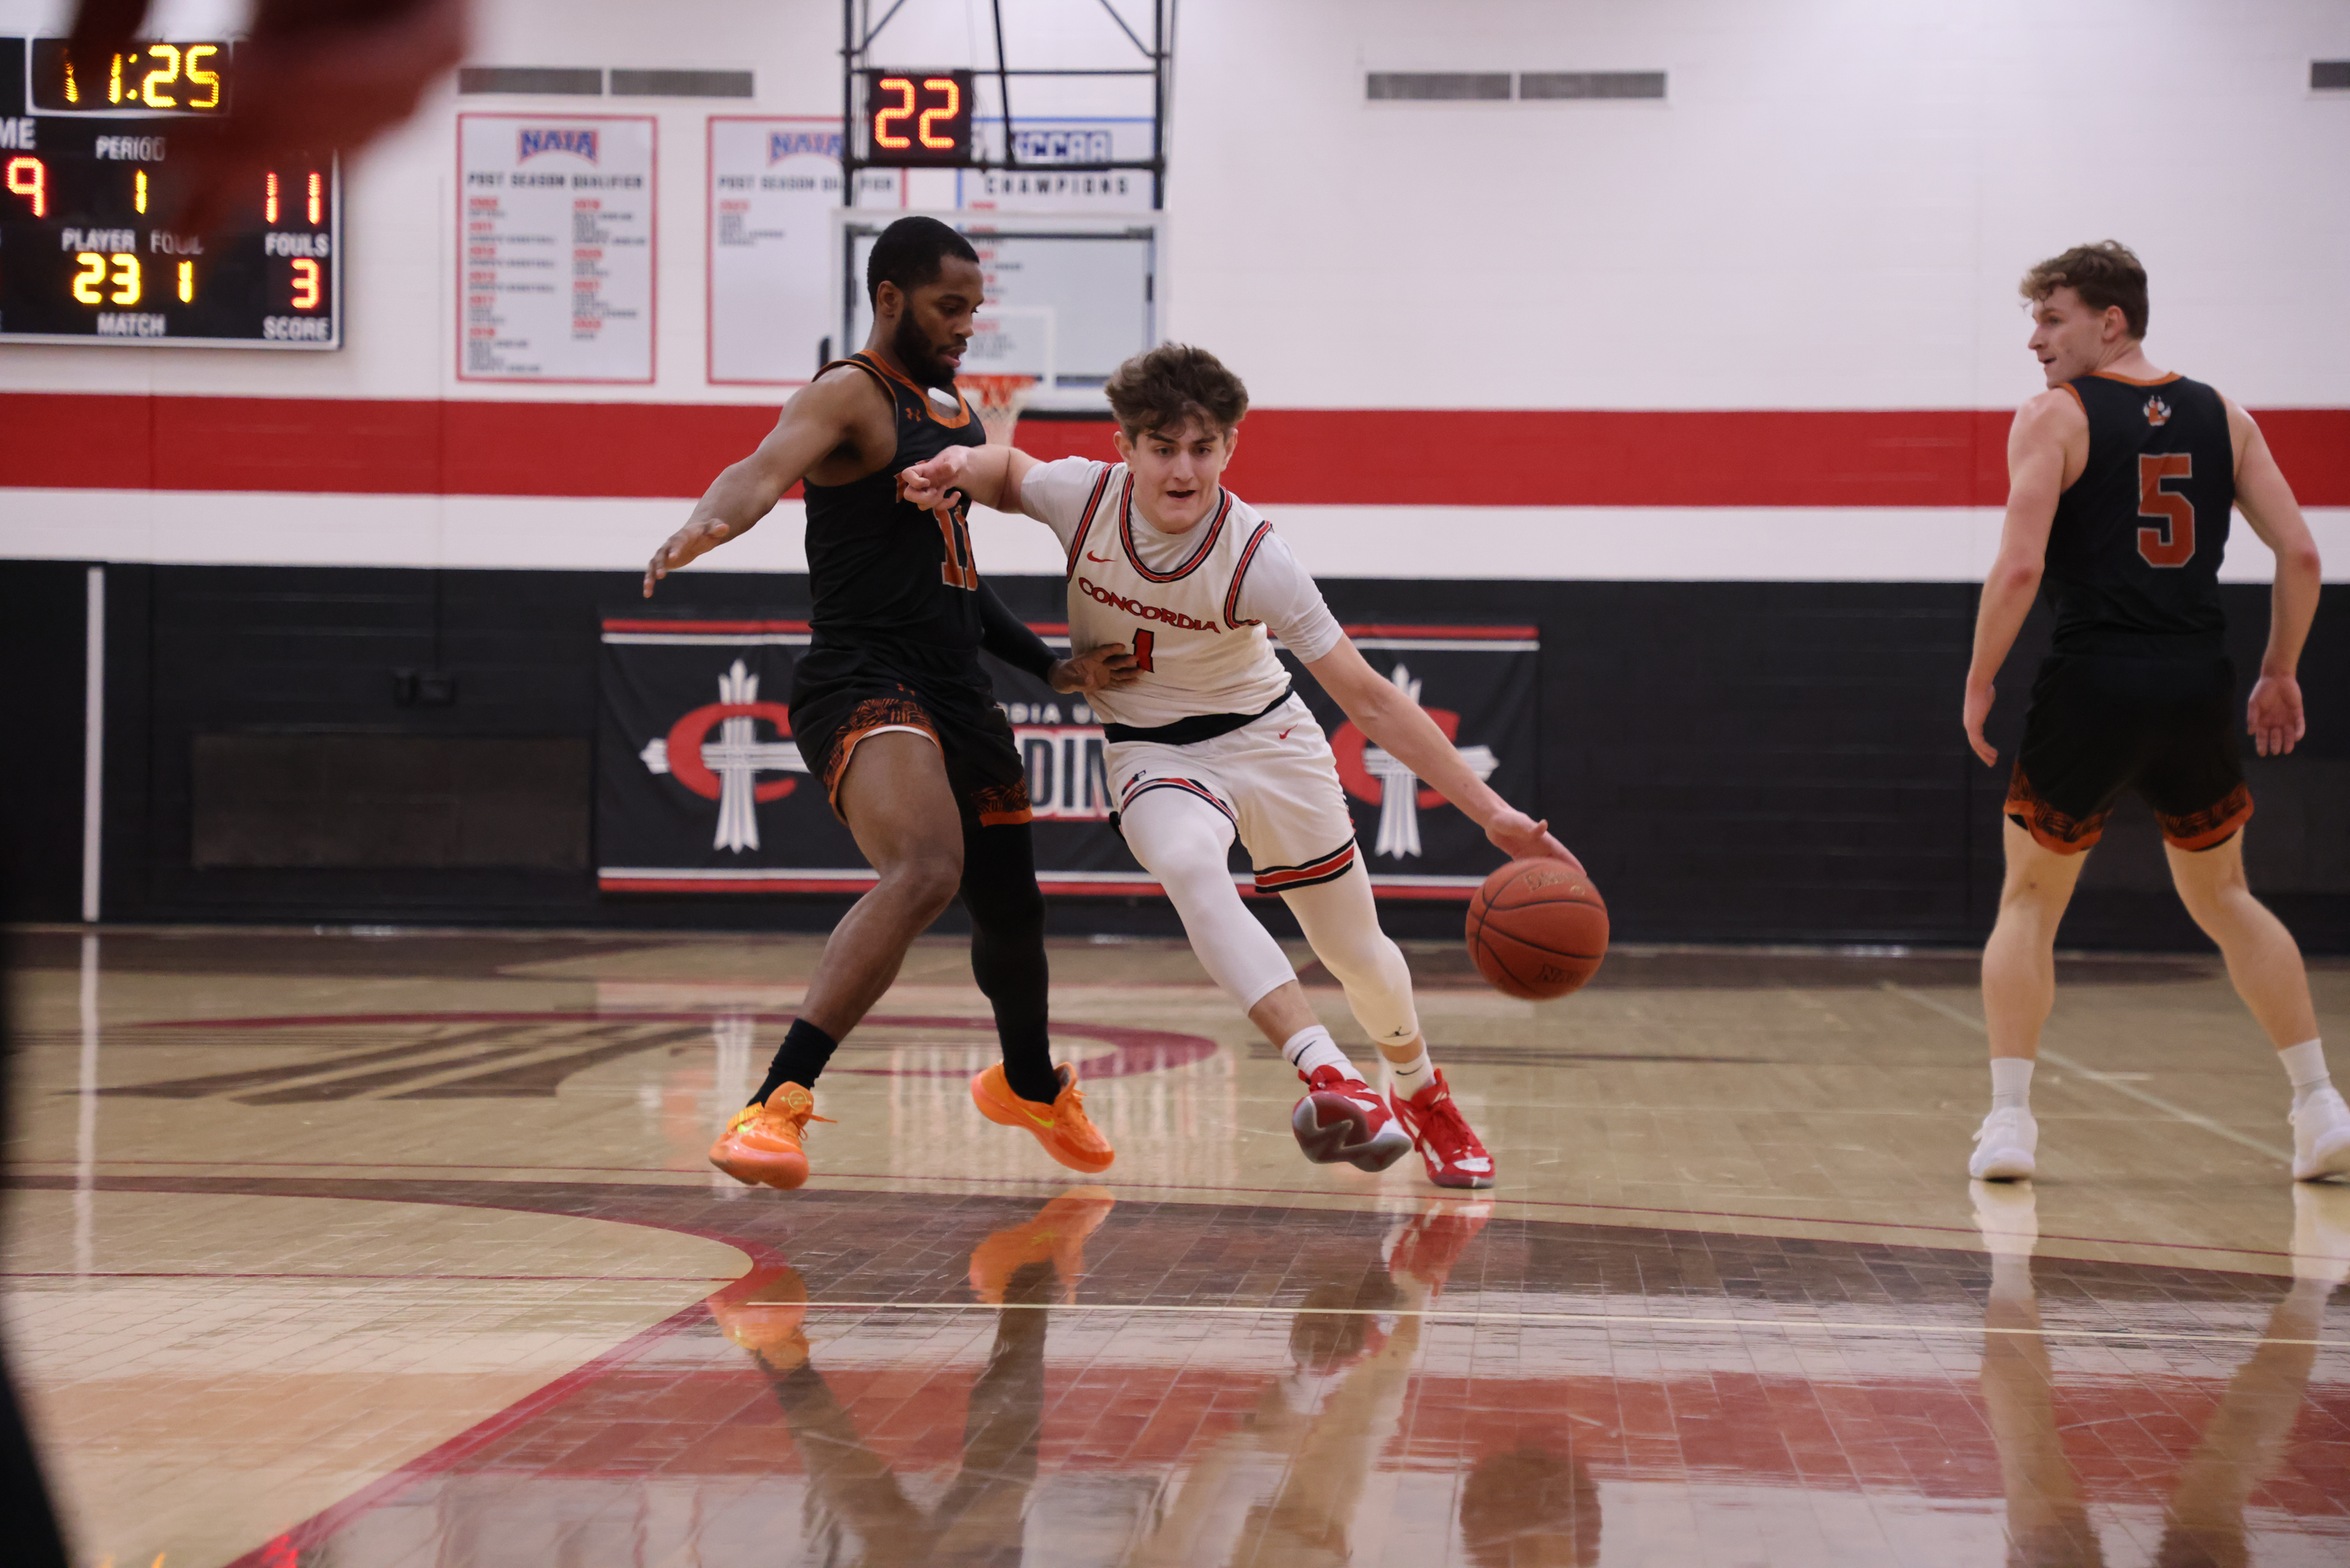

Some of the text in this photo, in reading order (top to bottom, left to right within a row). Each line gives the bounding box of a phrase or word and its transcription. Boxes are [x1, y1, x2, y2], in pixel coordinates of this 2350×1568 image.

[63, 44, 219, 108] 11:25
[875, 78, 959, 148] 22
[96, 135, 166, 161] PERIOD
[519, 130, 597, 160] NAIA
[7, 156, 46, 218] 9
[134, 168, 148, 214] 1
[265, 171, 322, 226] 11
[468, 172, 643, 189] POST SEASON QUALIFIER
[718, 175, 755, 190] POST
[760, 175, 816, 190] SEASON
[986, 176, 1130, 194] CHAMPIONS
[62, 228, 136, 252] PLAYER
[265, 232, 330, 257] FOULS
[73, 252, 141, 305] 23
[178, 260, 193, 303] 1
[290, 258, 321, 309] 3
[97, 314, 165, 337] MATCH
[263, 316, 329, 340] SCORE
[2137, 453, 2195, 568] 5
[1078, 577, 1221, 634] CONCORDIA
[1132, 628, 1155, 673] 1
